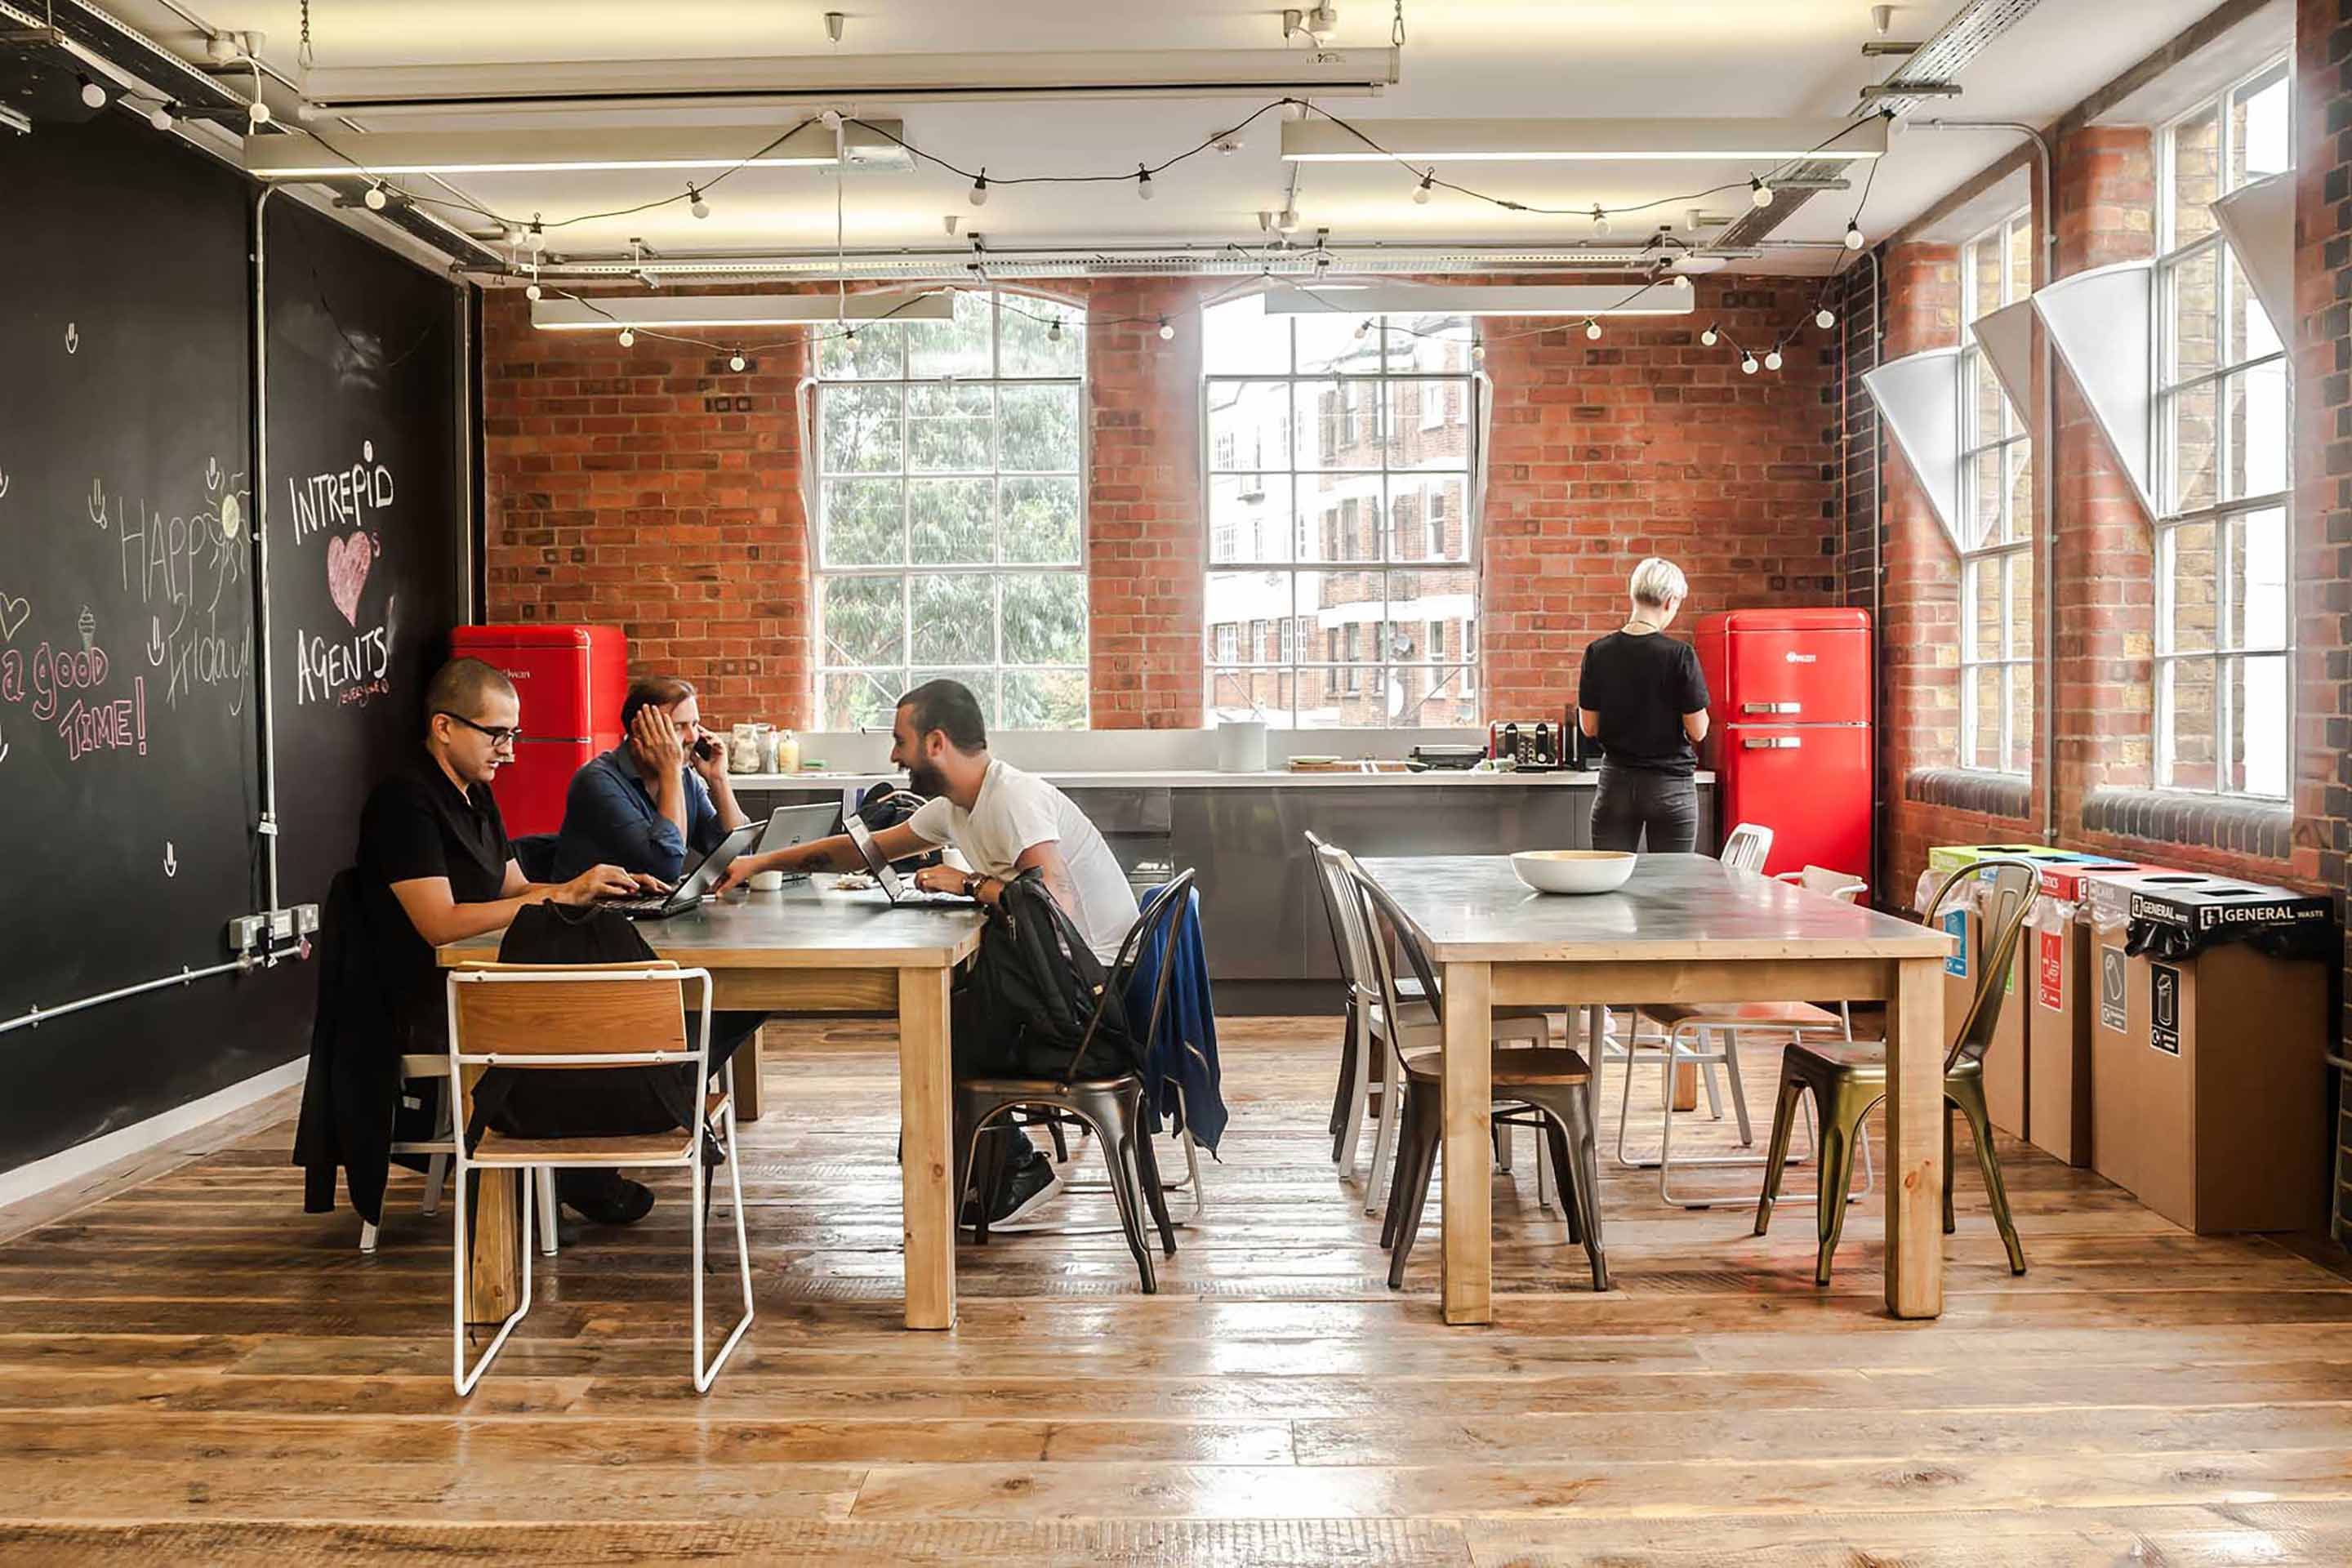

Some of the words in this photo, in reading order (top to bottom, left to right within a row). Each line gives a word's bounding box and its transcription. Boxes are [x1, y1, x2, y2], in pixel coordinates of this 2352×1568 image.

[298, 626, 388, 706] AGENTS
[2142, 901, 2175, 920] GENERAL
[2225, 906, 2296, 922] GENERAL
[2296, 910, 2324, 918] WASTE
